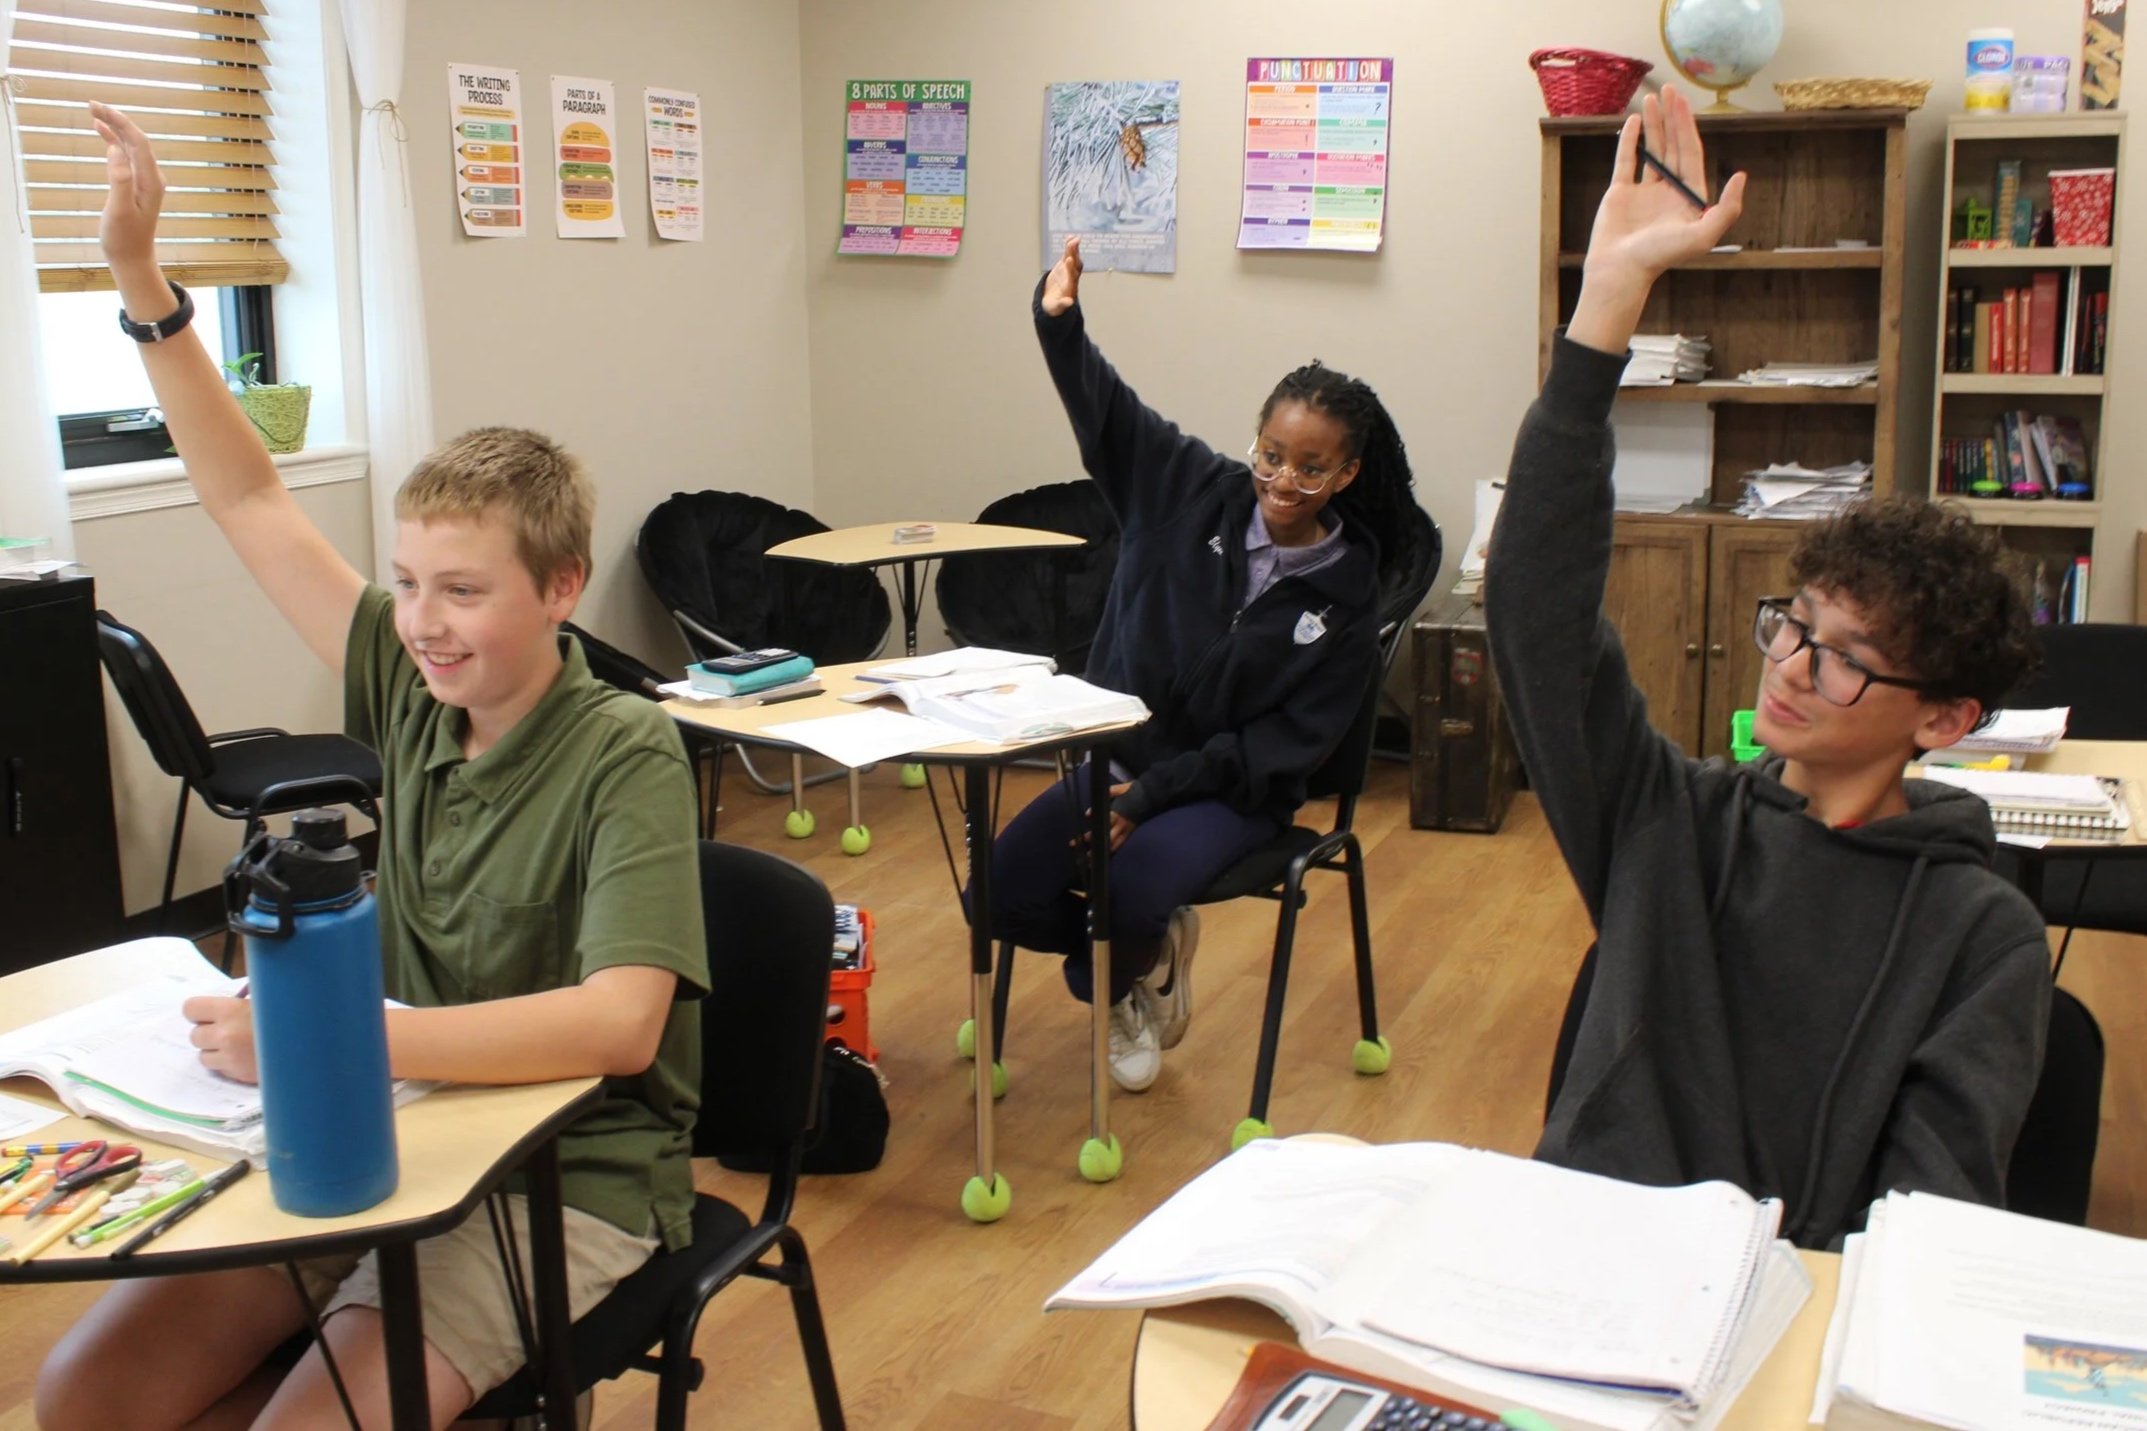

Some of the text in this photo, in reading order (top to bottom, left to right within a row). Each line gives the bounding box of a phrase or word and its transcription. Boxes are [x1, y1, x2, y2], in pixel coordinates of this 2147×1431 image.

[1259, 60, 1382, 81] PUNCTUATION
[459, 75, 511, 91] THE WRITING
[468, 91, 503, 105] PROCESS
[567, 89, 601, 100] PARTS OF A
[852, 83, 965, 100] 8 PARTS OF SPEECH
[563, 100, 606, 115] PARAGRAPH
